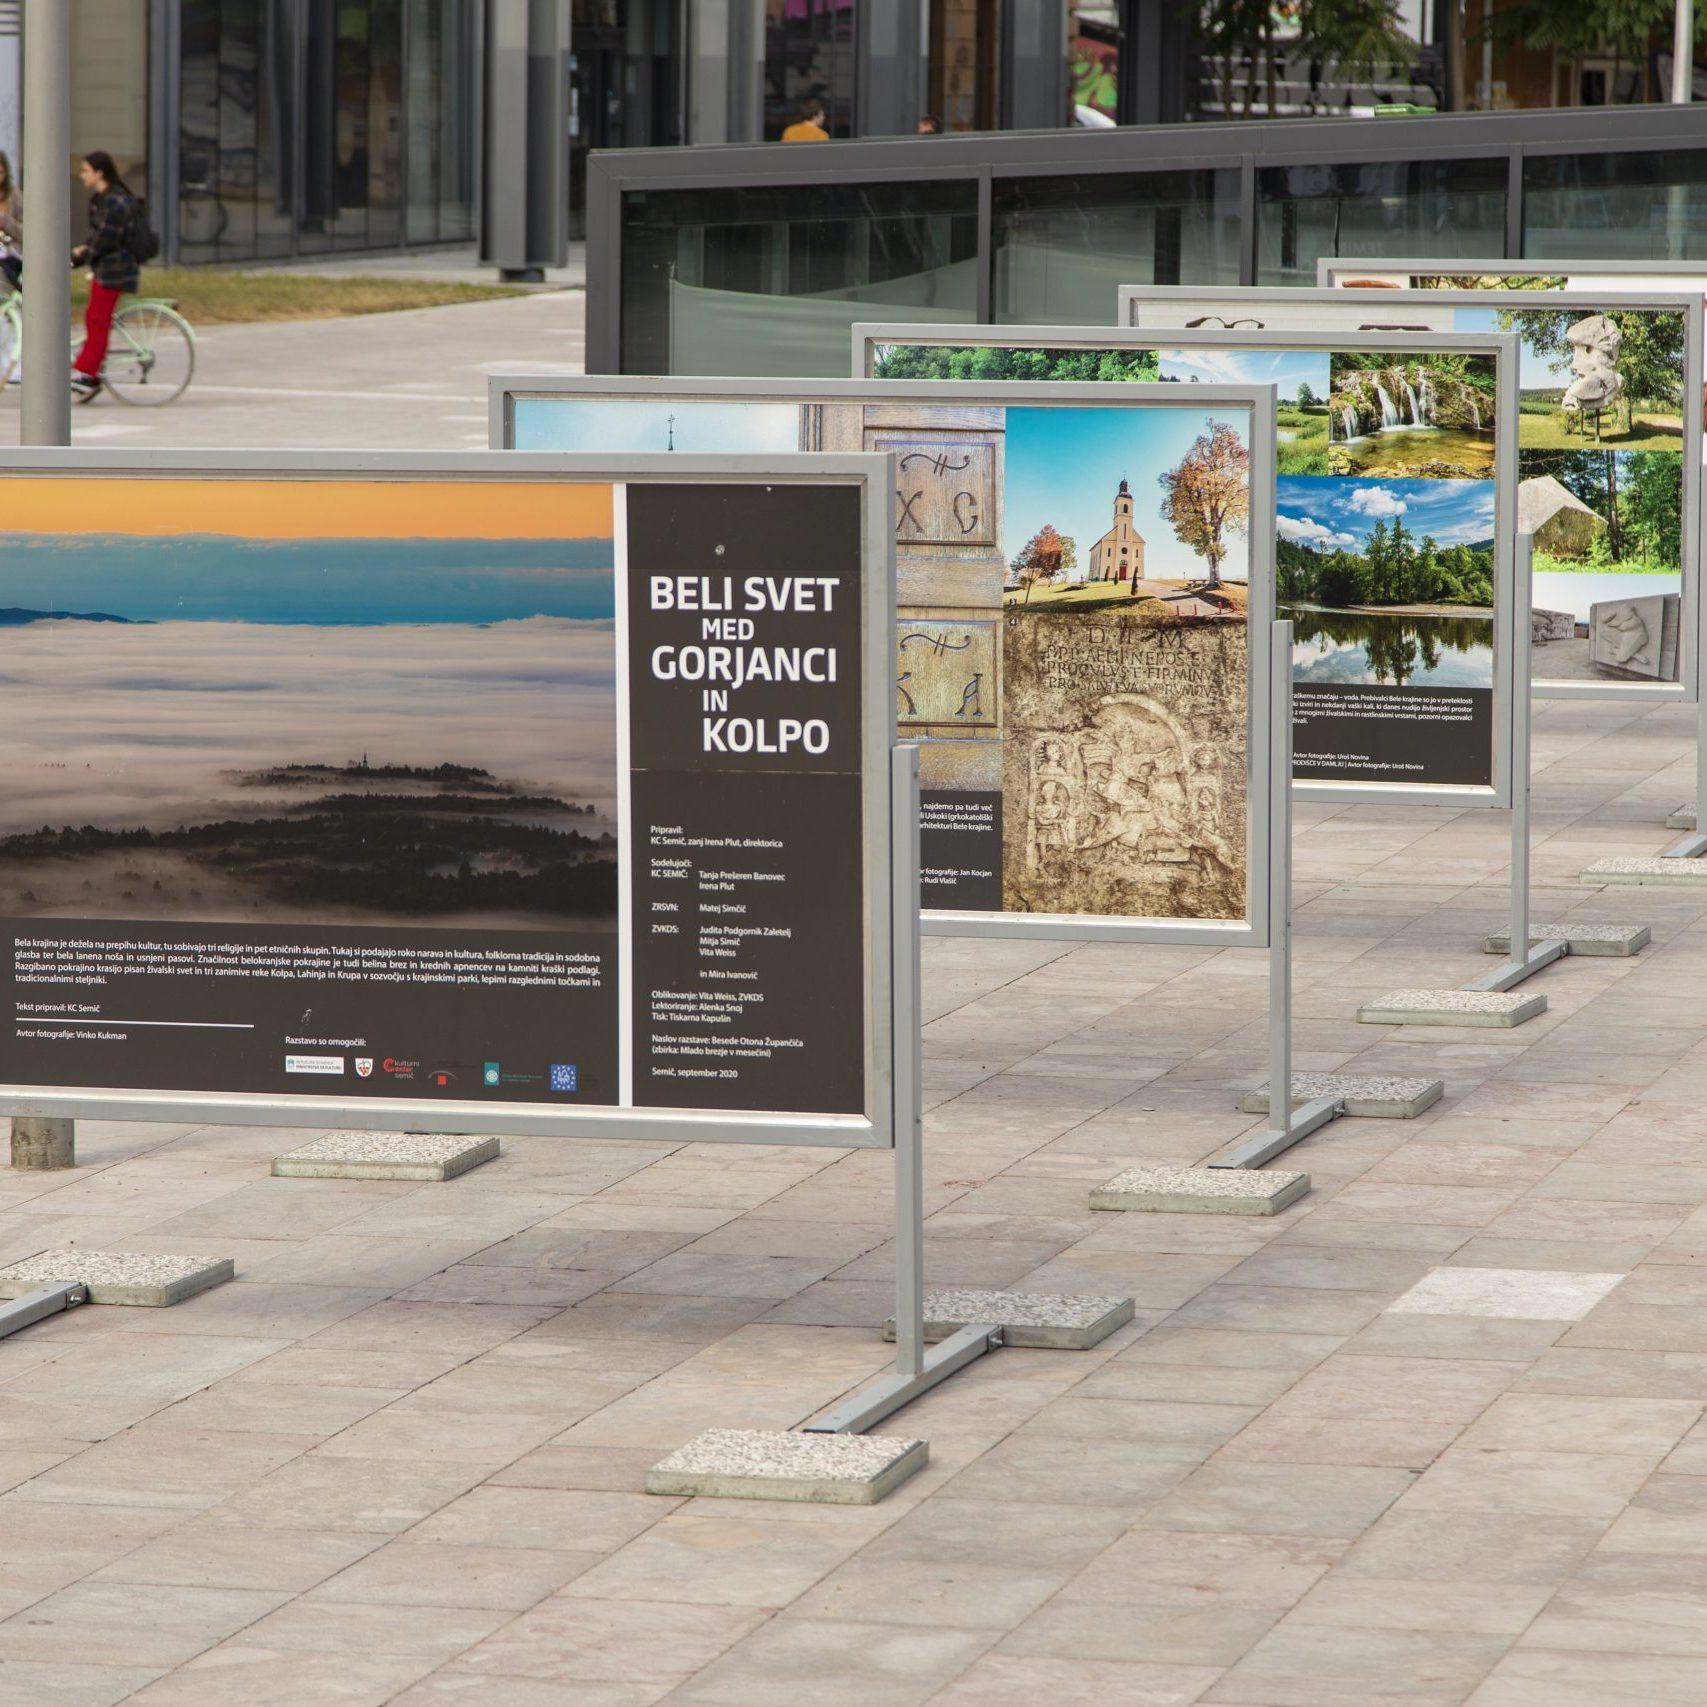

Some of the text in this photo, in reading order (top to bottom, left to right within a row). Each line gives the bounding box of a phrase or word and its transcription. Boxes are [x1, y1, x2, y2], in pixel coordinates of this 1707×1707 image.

[651, 576, 840, 612] BELI SVET
[702, 618, 755, 640] MED
[651, 646, 837, 690] GORJANCI
[703, 690, 728, 712] IN
[703, 718, 830, 755] KOLPO
[924, 803, 953, 812] najdemo
[925, 812, 948, 820] Uskoki
[948, 812, 993, 823] (grkokatoliški
[651, 825, 683, 836] Pripravil:
[953, 822, 993, 832] Bele krajine.
[663, 836, 783, 849] Semič, zanj Irena Plut, direktorica
[651, 858, 692, 869] Sodelujoči:
[663, 867, 688, 878] SEMIČ:
[699, 870, 785, 881] Tanja Prešeren Banovec
[699, 881, 735, 891] Irena Plut
[652, 903, 679, 912] ZRSVN:
[700, 903, 747, 914] Matej Simčič
[652, 924, 679, 933] ZVKDS:
[700, 926, 791, 939] Judita Podgornik Zaletelj
[700, 937, 741, 948] Mitja Simič
[15, 938, 31, 947] Bela
[33, 939, 58, 950] krajina
[69, 940, 93, 949] dežela
[106, 941, 136, 952] prepihu
[138, 942, 162, 952] kultur,
[173, 943, 206, 954] sobivajo
[208, 943, 216, 952] tri
[217, 944, 244, 955] religije
[255, 945, 267, 955] pet
[269, 945, 301, 954] etničnih
[302, 946, 331, 957] skupin.
[332, 947, 353, 957] Tukaj
[362, 947, 396, 959] podajajo
[398, 948, 416, 957] roko
[454, 950, 484, 961] kultura,
[485, 951, 521, 960] folklorna
[522, 952, 554, 963] tradicija
[565, 953, 600, 962] sodobna
[699, 947, 736, 957] Vita Weiss
[15, 950, 600, 977] glasba ter bela lanena noša usnjeni pasovi. Značilnost belokranjske pokrajine tudi belina brez krednih apnencev kamniti kraški podlagi.
[15, 962, 590, 987] Razgibano pokrajino krasijo pisan živalski svet tri zanimive reke Kolpa, Lahinja Krupa sozvočju krajinskimi parki, lepimi razglednimi točkami
[15, 973, 107, 986] tradicionalnimi steljniki.
[652, 990, 764, 1003] Oblikovanje: Vita Weiss, ZVKDS
[16, 1002, 100, 1014] Tekst pripravil: Semič
[652, 1001, 743, 1014] Lektoriranje: Alenka Snoj
[652, 1012, 731, 1025] Tisk: Tiskarna Kapušin
[16, 1029, 127, 1040] Avtor fotografije: Vinko Kukman
[285, 1036, 367, 1048] Razstavo omogočili:
[652, 1034, 803, 1048] Naslov razstave: Besede Otona Župančiča
[652, 1045, 771, 1058] (zbirka: Mlado brezje mesečini)
[652, 1067, 738, 1079] Semič, september 2020
